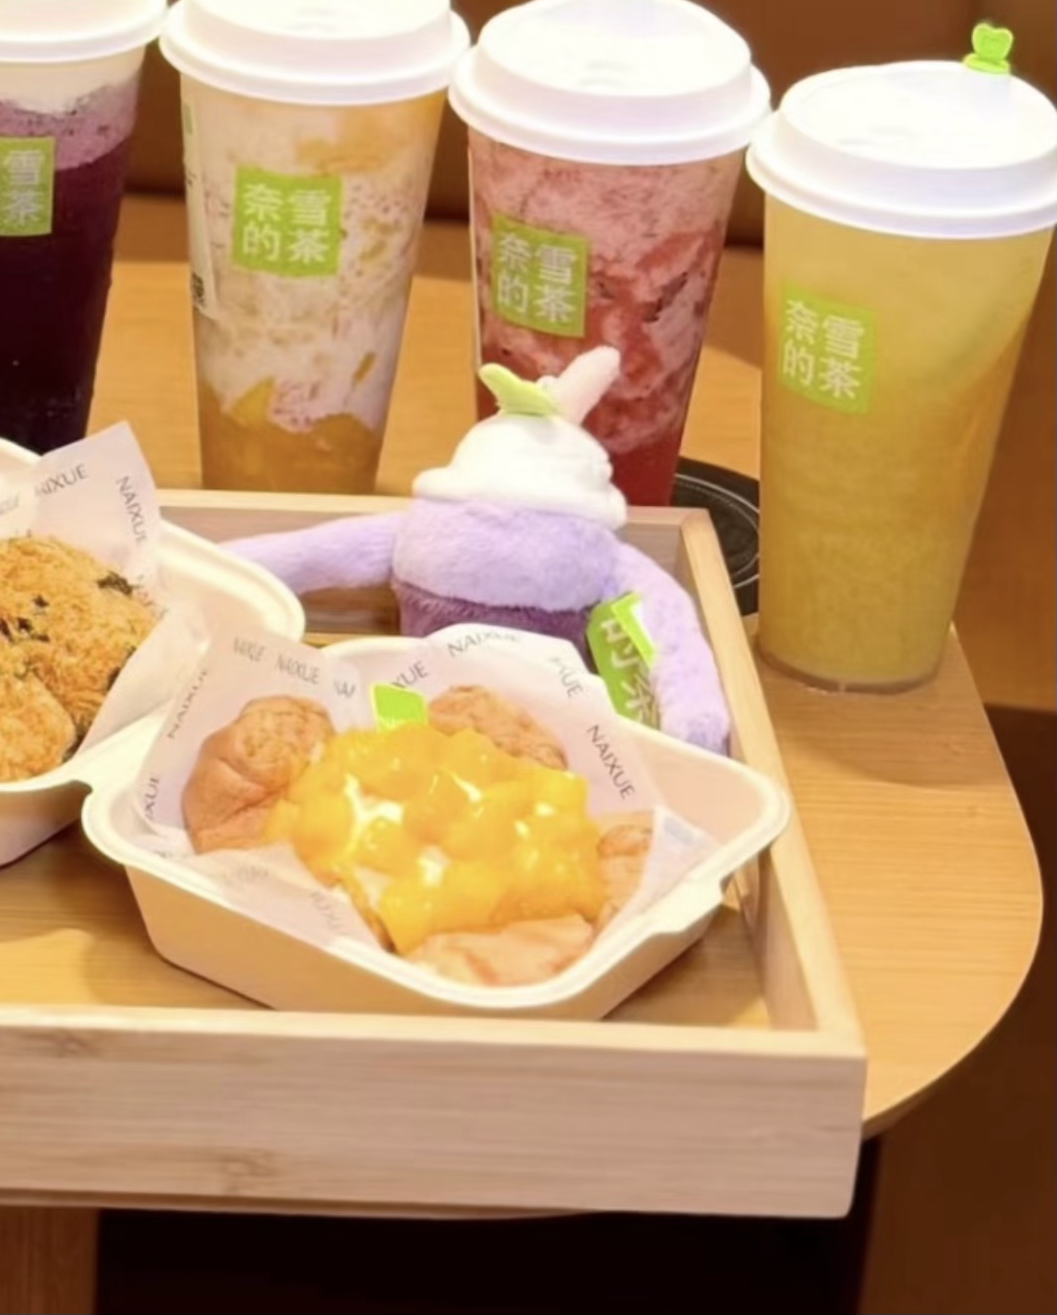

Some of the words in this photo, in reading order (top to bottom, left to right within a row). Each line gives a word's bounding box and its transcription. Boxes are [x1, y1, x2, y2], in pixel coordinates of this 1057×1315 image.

[244, 183, 332, 226] 奈雪
[242, 224, 330, 265] 的茶
[498, 231, 576, 286] 奈雪
[496, 274, 574, 324] 的茶
[786, 299, 864, 360] 奈雪
[783, 338, 862, 400] 的茶
[587, 724, 636, 800] NAIXUE
